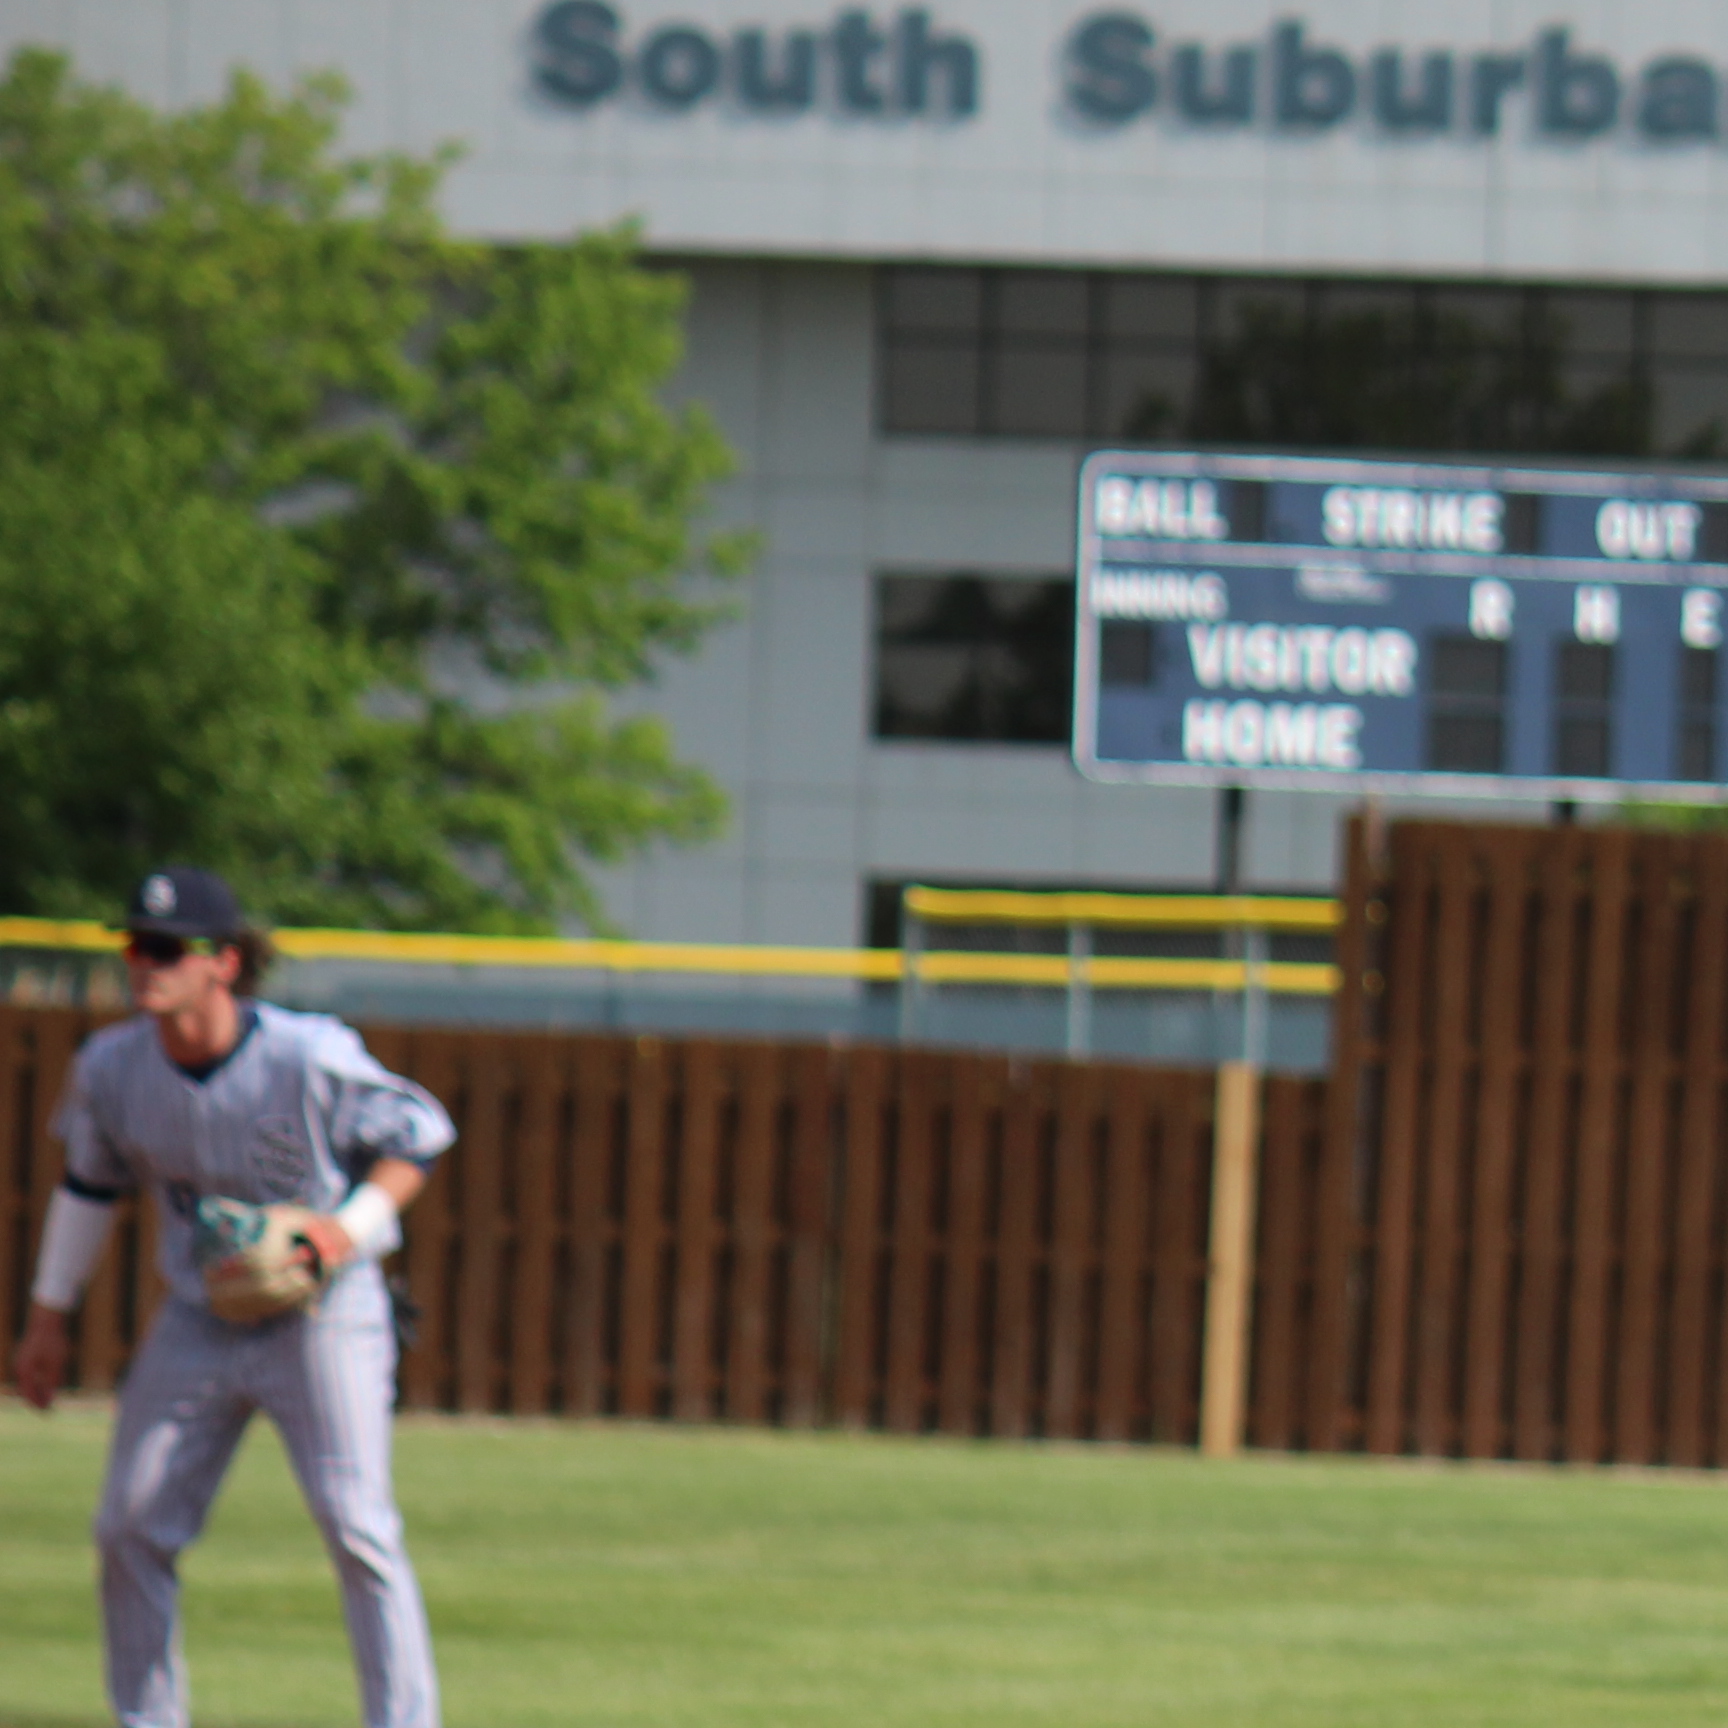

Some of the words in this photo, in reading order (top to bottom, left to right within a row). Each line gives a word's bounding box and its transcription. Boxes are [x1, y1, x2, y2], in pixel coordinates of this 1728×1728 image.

[532, 0, 980, 112] South
[1097, 475, 1228, 541] BALL
[1322, 487, 1503, 552] STRIKE
[1596, 499, 1700, 560] OUT
[1468, 576, 1514, 640] R
[1573, 581, 1620, 645] H
[1681, 586, 1722, 649] E
[1186, 621, 1417, 696] VISITOR
[1182, 697, 1363, 769] HOME
